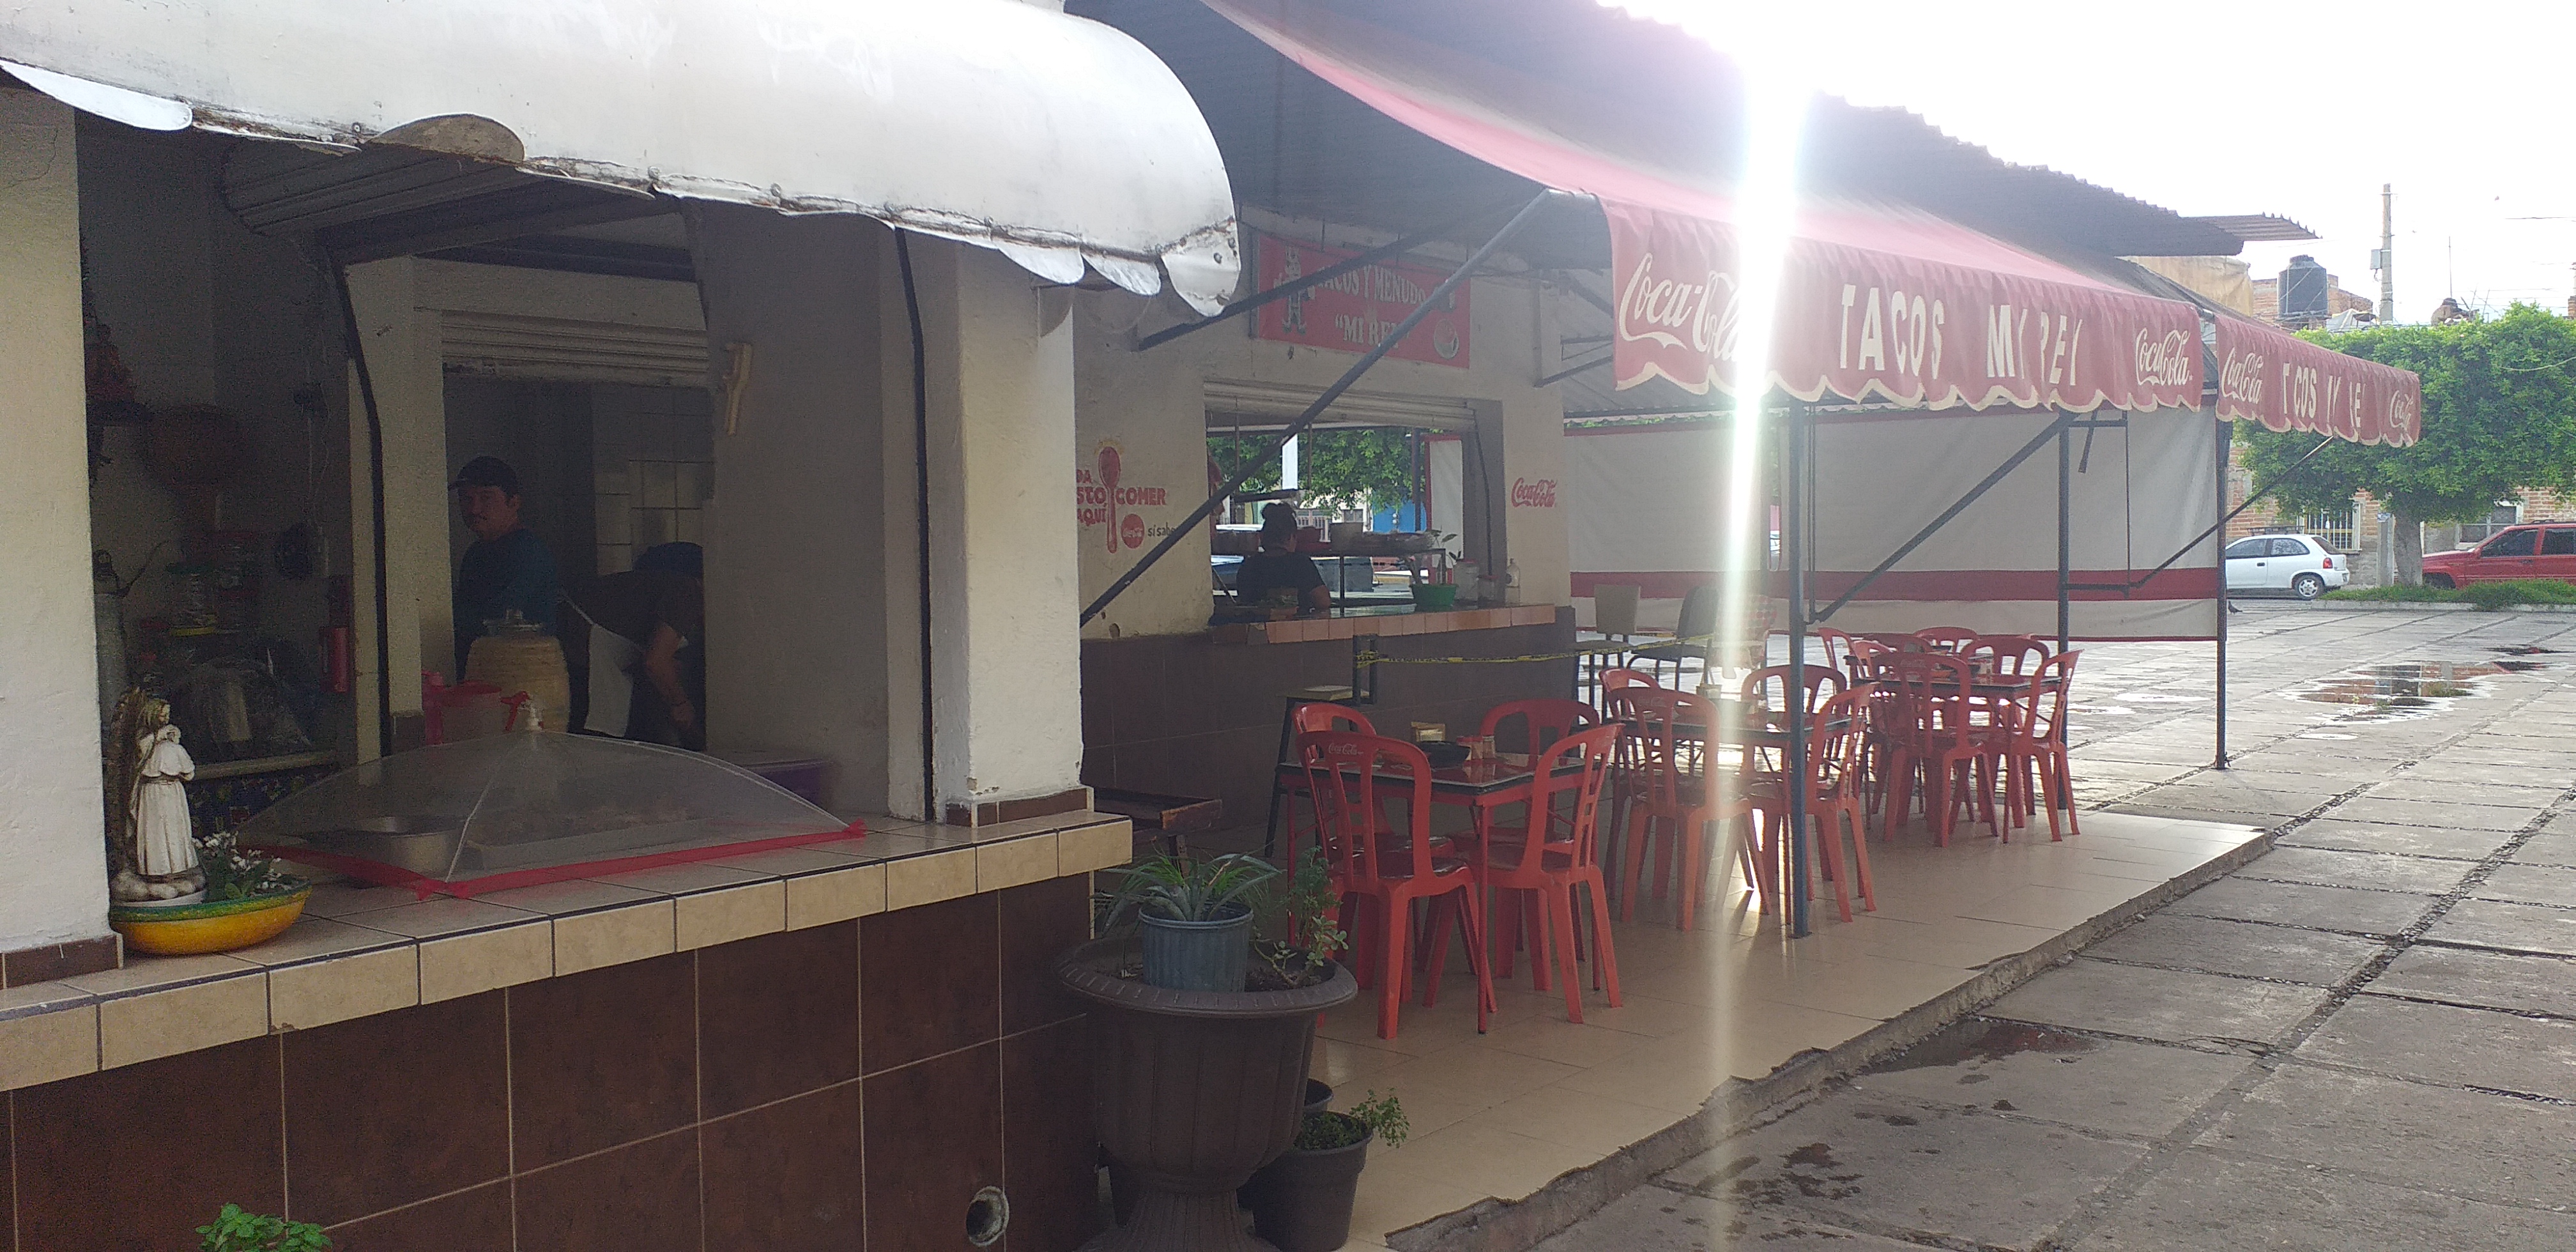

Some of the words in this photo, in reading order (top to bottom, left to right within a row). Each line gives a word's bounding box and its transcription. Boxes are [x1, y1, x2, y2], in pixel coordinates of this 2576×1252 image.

[1318, 269, 1360, 296] ACOS
[1363, 264, 1372, 300] Y
[1374, 264, 1426, 305] MENUDO
[1840, 284, 1945, 379] TACOS
[2136, 327, 2190, 386] CocaCola
[2283, 362, 2317, 418] TCOS
[1077, 487, 1107, 505] STO
[1115, 487, 1167, 505] COMER
